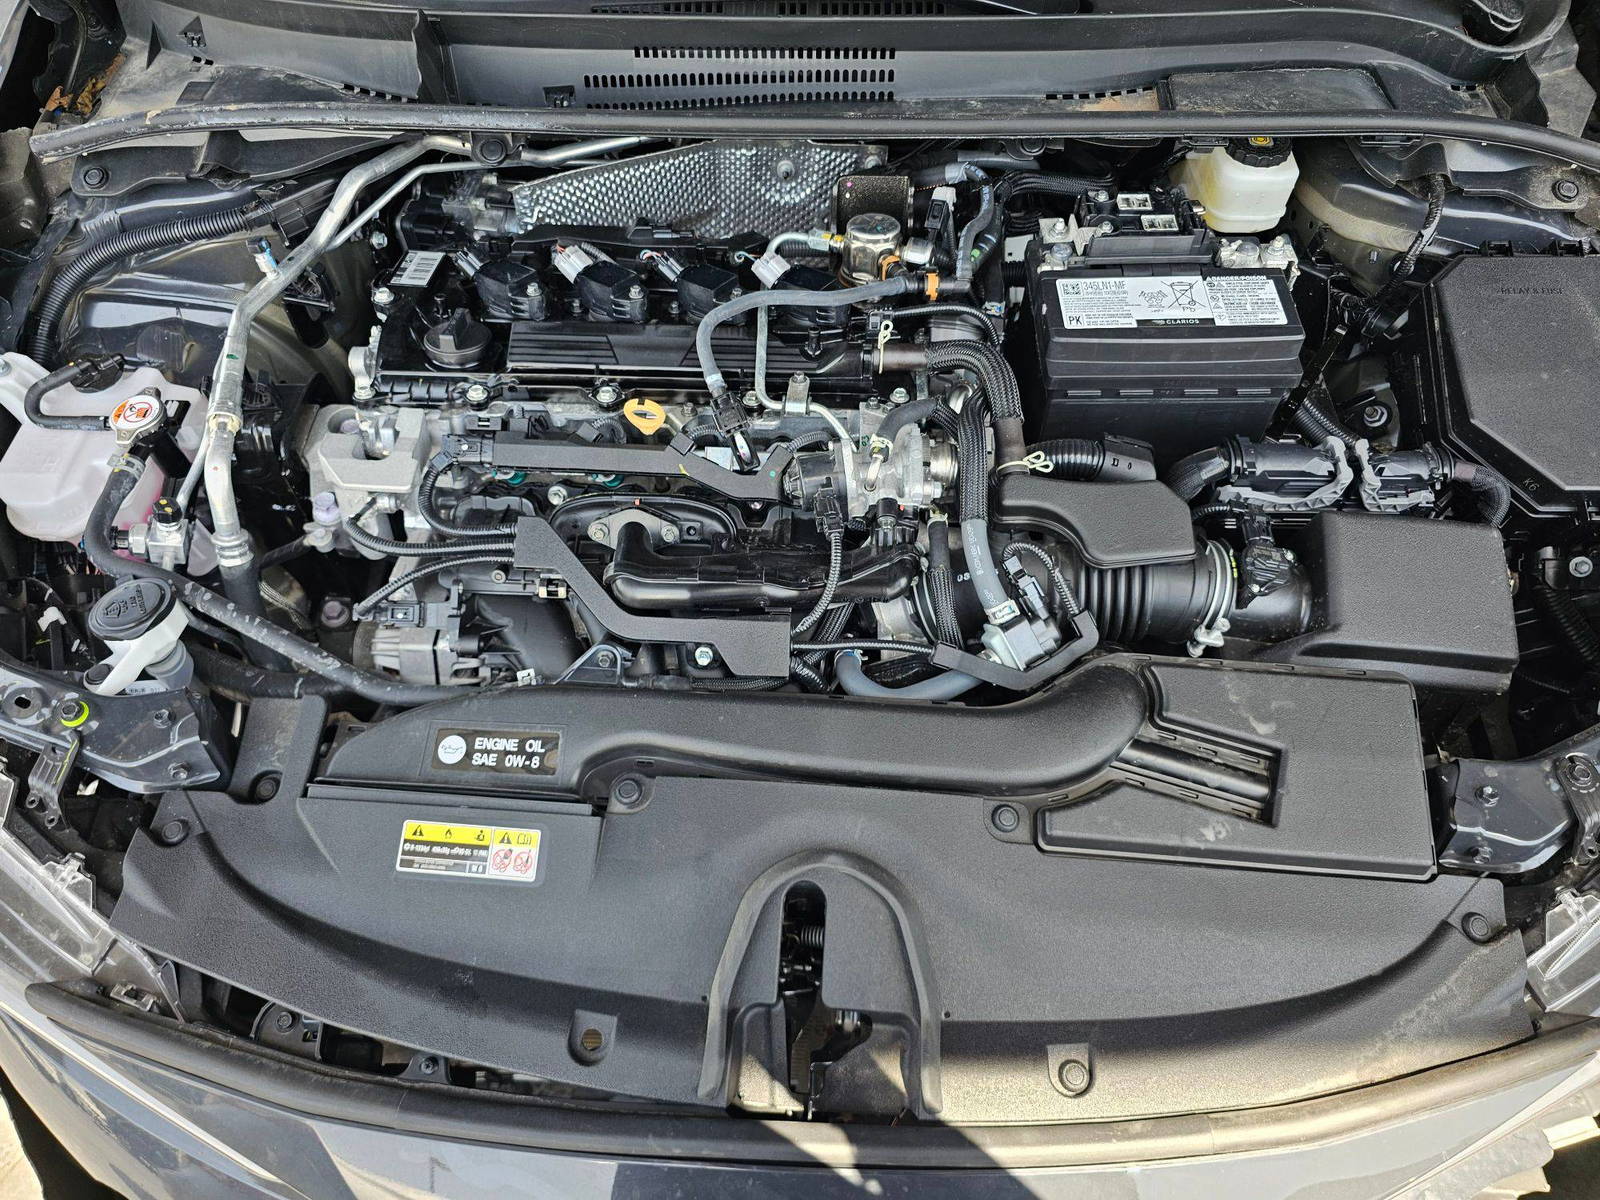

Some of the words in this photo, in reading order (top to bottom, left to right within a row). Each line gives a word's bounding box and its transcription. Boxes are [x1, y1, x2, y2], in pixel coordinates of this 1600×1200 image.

[1068, 315, 1083, 326] PK
[474, 738, 519, 751] ENGINE
[525, 739, 546, 753] OIL
[471, 752, 498, 767] SAE
[504, 755, 540, 769] 0W-8
